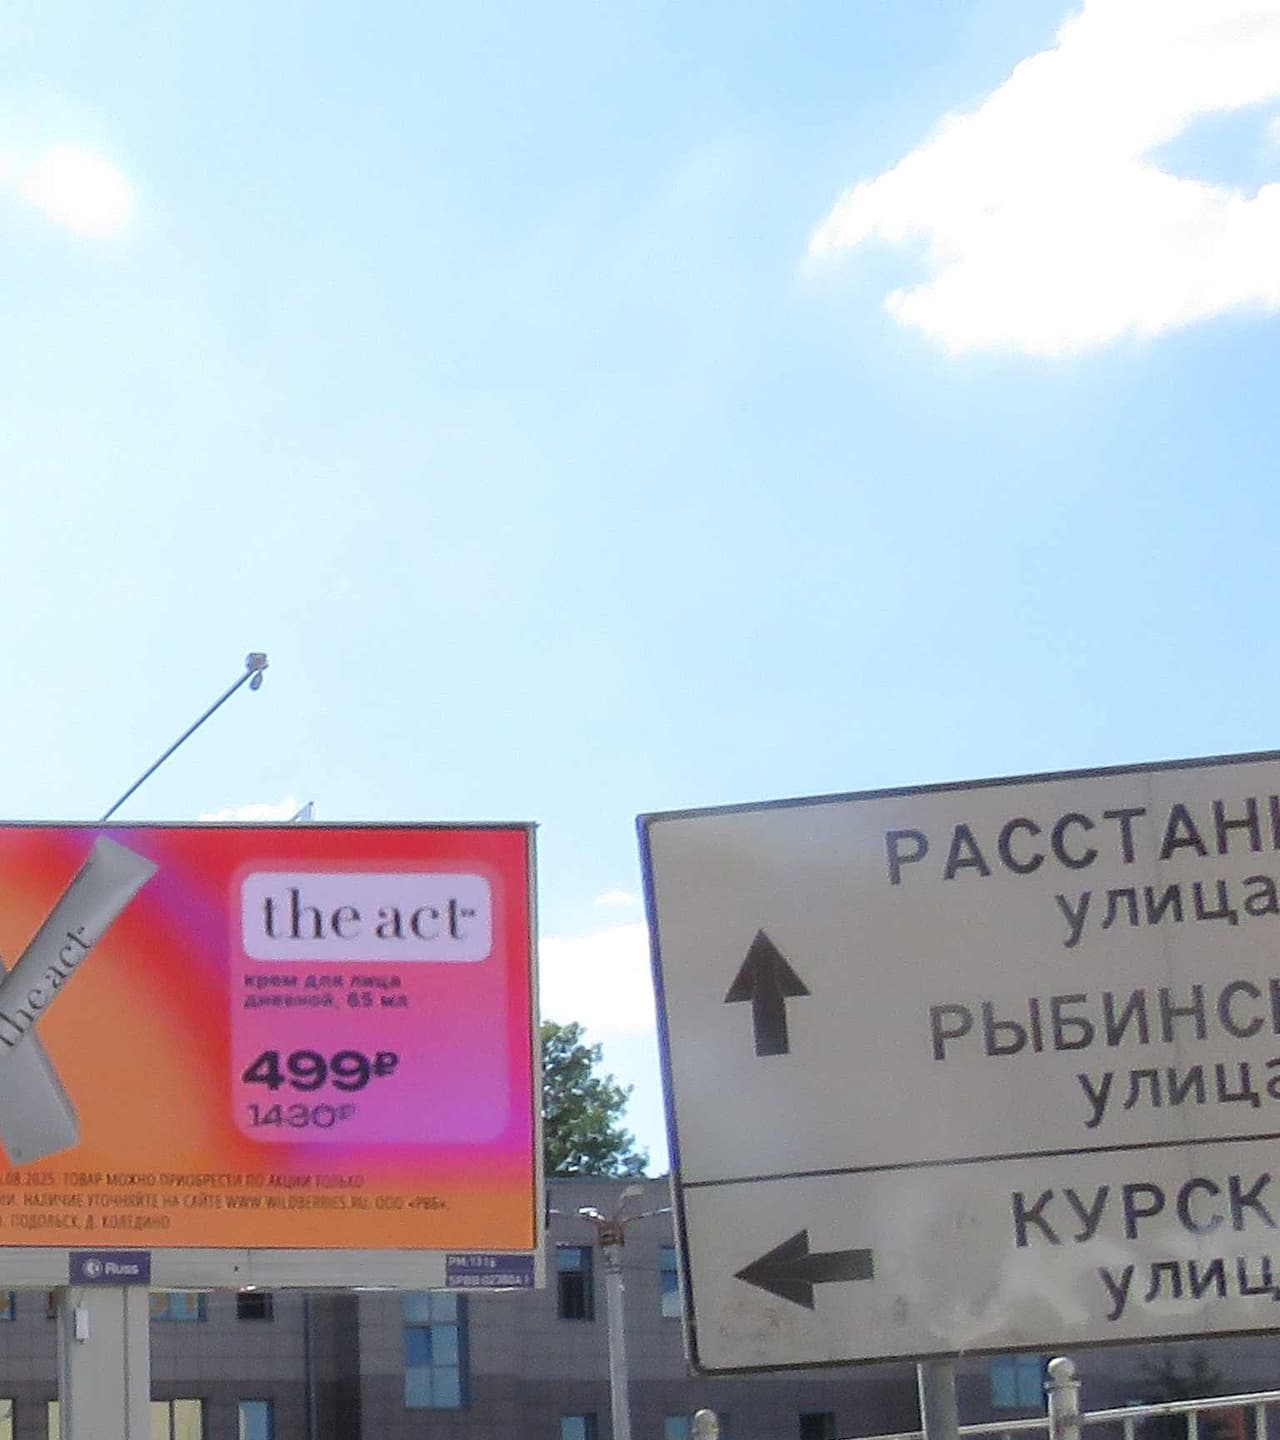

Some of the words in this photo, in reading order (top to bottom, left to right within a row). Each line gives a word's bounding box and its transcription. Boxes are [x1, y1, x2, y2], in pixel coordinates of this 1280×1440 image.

[262, 887, 363, 941] the
[1054, 874, 1280, 949] улица
[1011, 1172, 1280, 1249] КУРСК
[105, 1262, 140, 1275] Russ
